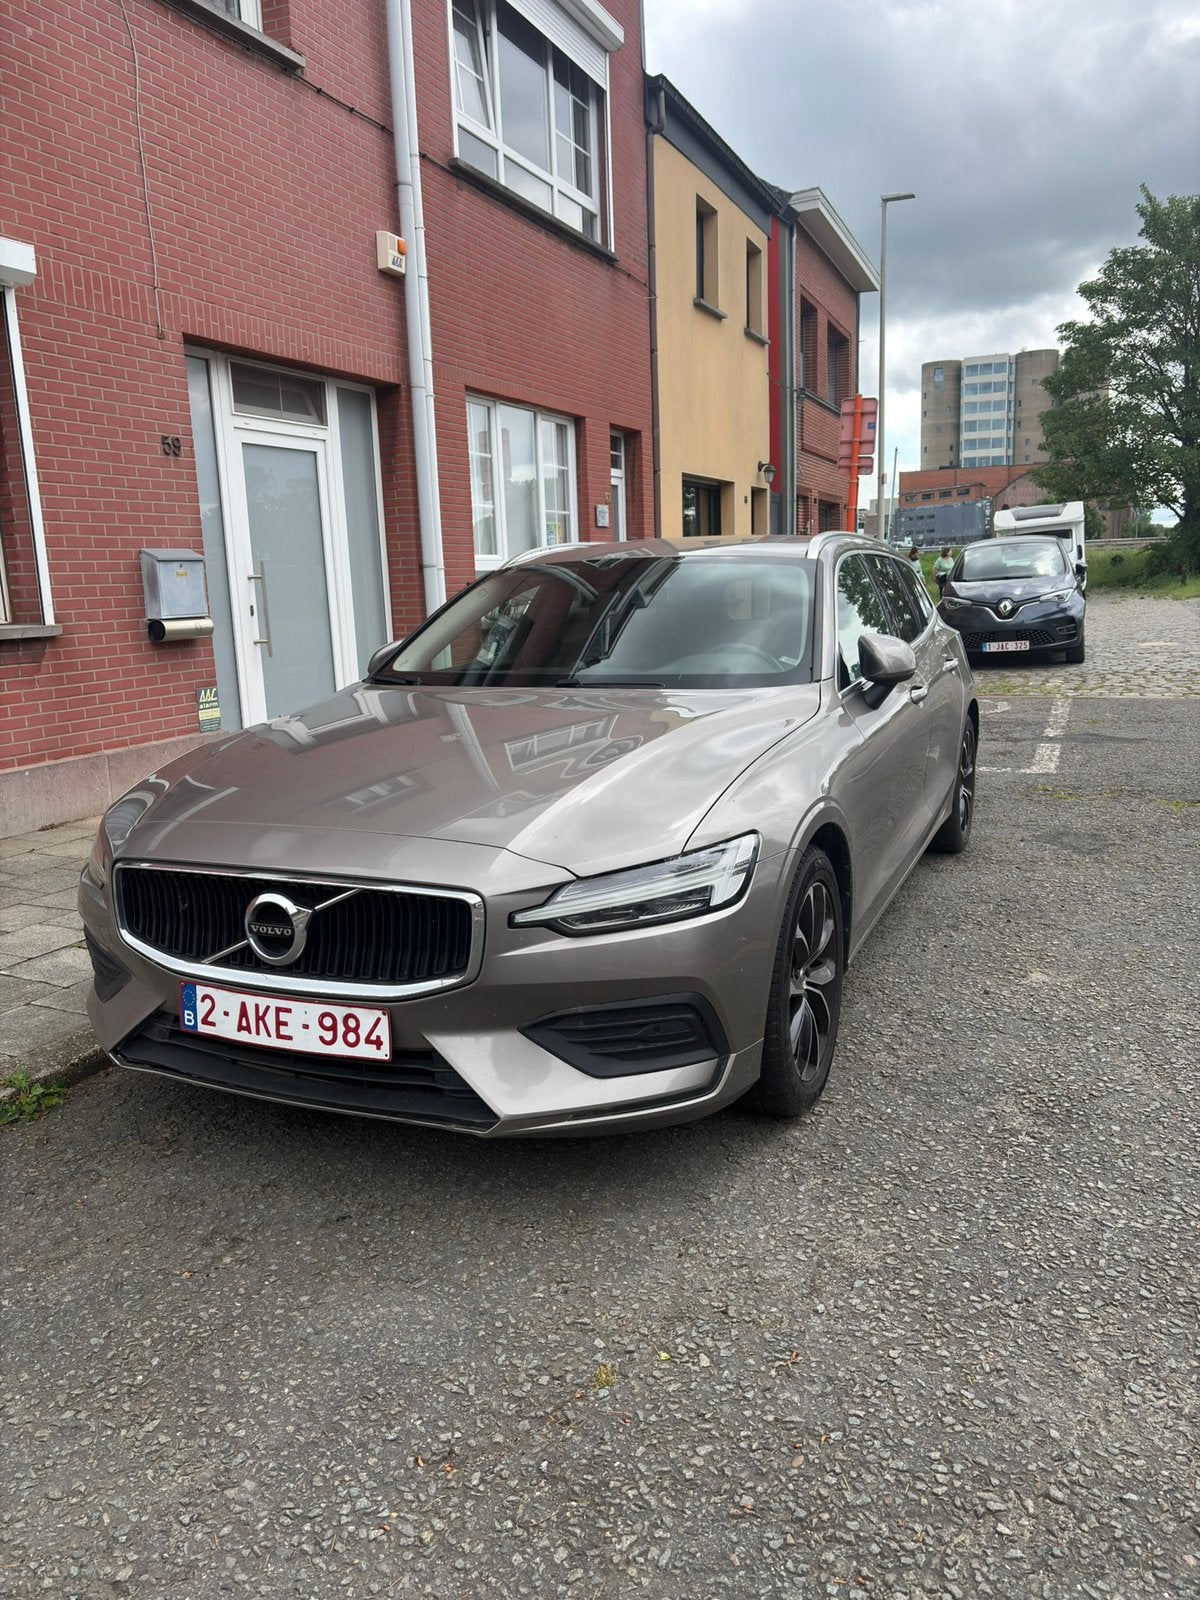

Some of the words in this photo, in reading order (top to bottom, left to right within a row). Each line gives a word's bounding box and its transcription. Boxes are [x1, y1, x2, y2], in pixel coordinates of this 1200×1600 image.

[161, 434, 181, 455] 59
[199, 688, 218, 702] AAC
[250, 924, 292, 936] VOLVO
[184, 1010, 195, 1026] B
[200, 993, 384, 1051] 2-AKE-984
